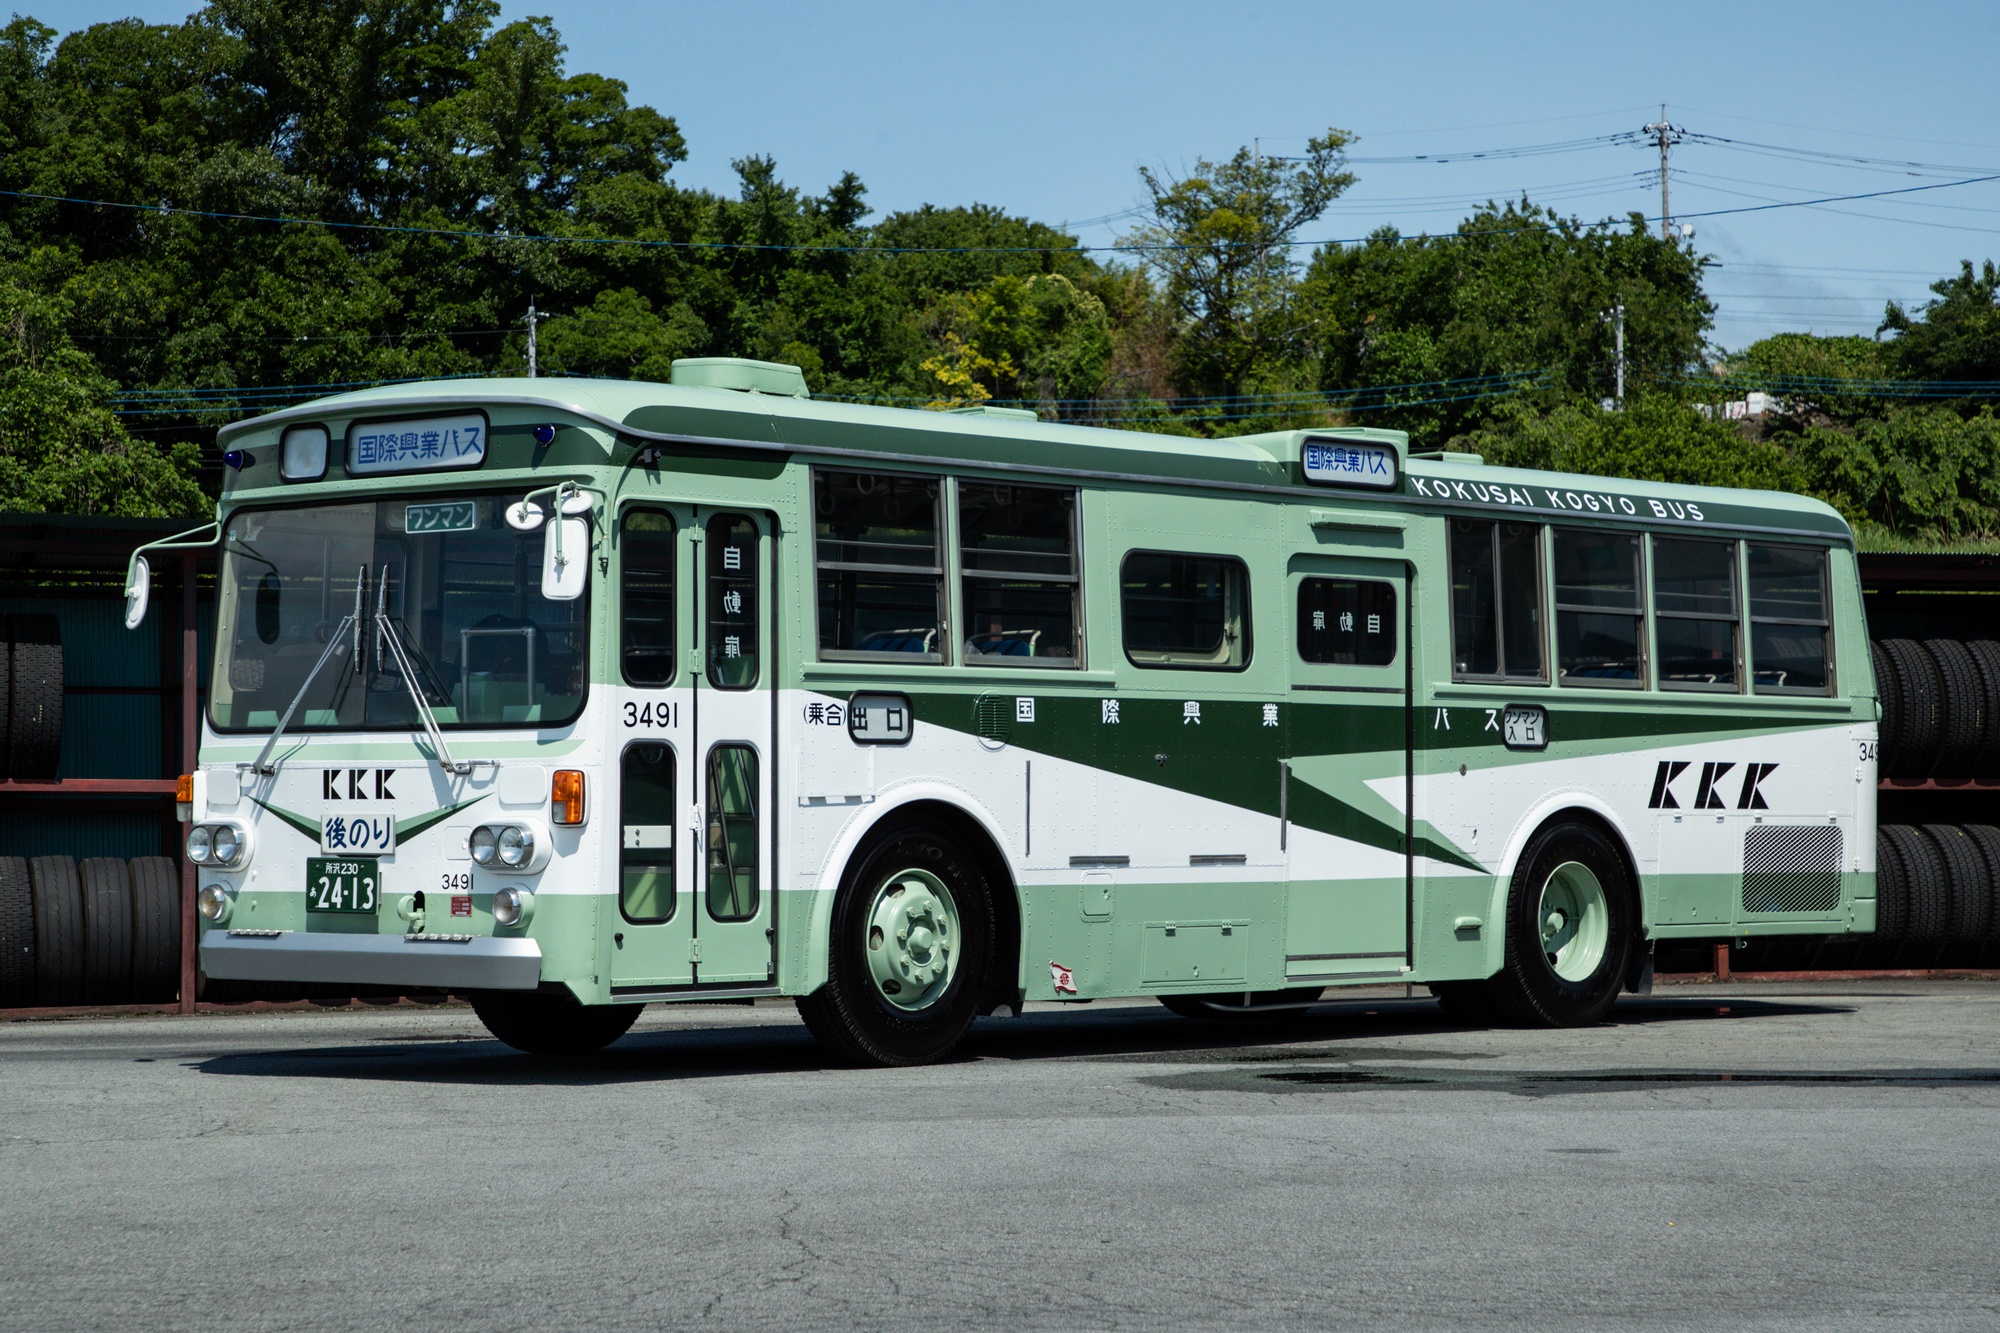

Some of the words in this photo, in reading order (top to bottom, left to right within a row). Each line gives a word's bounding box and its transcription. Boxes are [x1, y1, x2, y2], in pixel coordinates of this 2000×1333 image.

[358, 427, 483, 464] 国際興業バス
[1307, 444, 1387, 475] 国際興業バス
[1410, 477, 1534, 506] KOKUSAI
[1545, 489, 1636, 515] KOGYO
[1648, 500, 1704, 521] BUS
[408, 506, 472, 529] ワンマン
[623, 701, 677, 728] 3491
[852, 707, 903, 732] 出口
[1508, 726, 1536, 741] 入口
[323, 769, 397, 800] KKK
[1647, 760, 1781, 810] KKK
[325, 816, 391, 850] 後のり
[309, 886, 318, 898] あ
[441, 873, 474, 890] 3491
